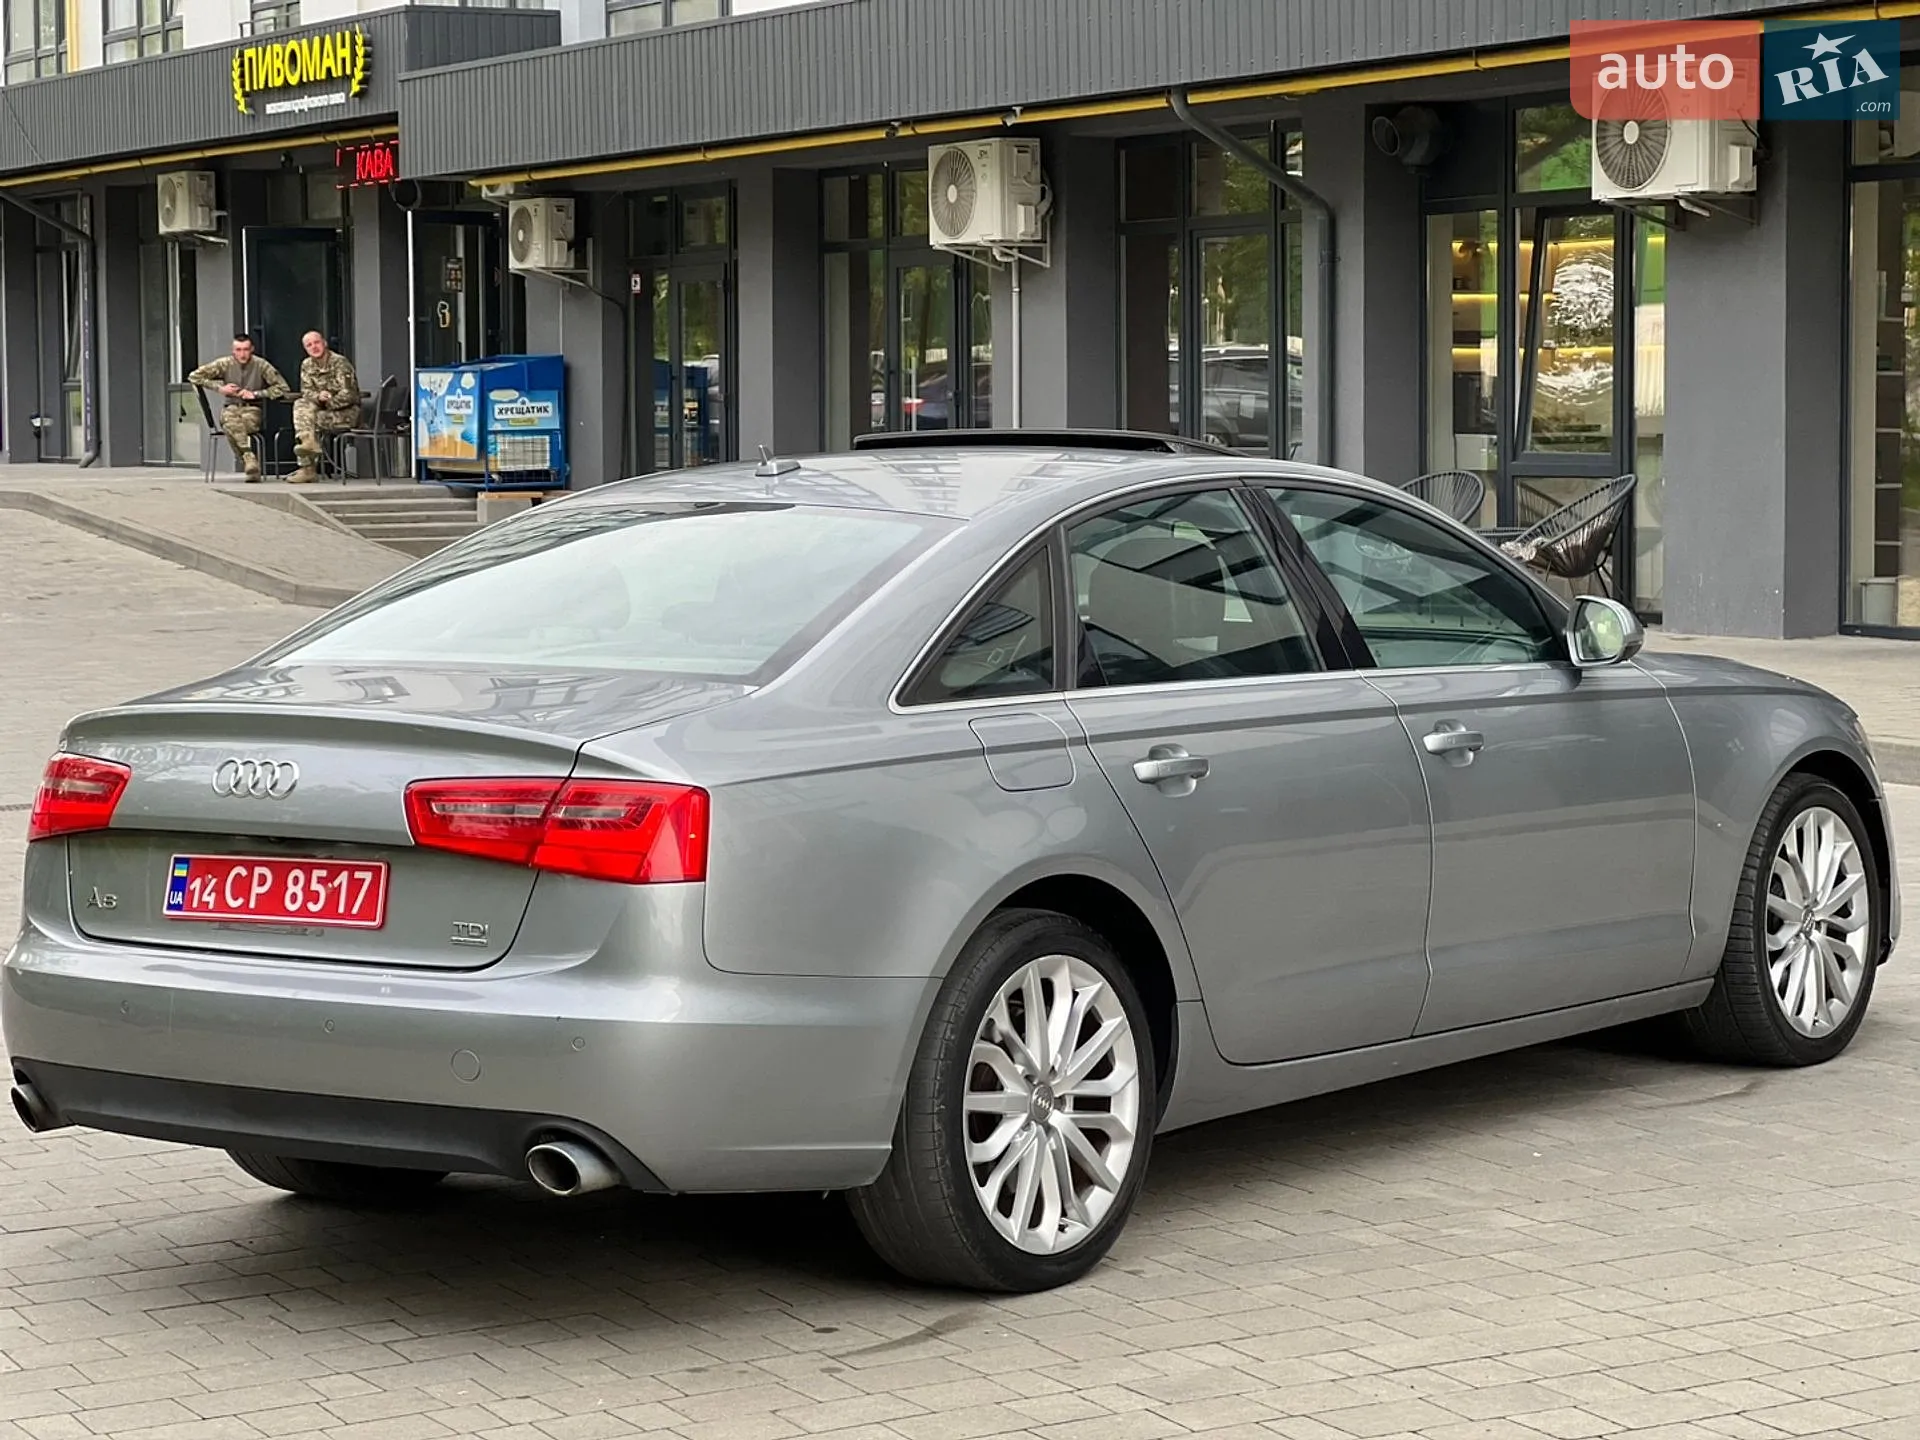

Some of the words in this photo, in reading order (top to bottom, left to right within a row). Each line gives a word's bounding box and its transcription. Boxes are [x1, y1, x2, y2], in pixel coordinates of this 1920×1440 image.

[244, 30, 351, 92] ПИВОМАН
[356, 147, 393, 180] КАВА
[497, 405, 550, 416] ХРЕЩАТИК
[86, 886, 117, 909] A6
[170, 890, 183, 905] UA
[189, 877, 218, 910] 14
[224, 865, 274, 910] CP
[283, 868, 374, 915] 8517
[452, 921, 489, 937] TDI
